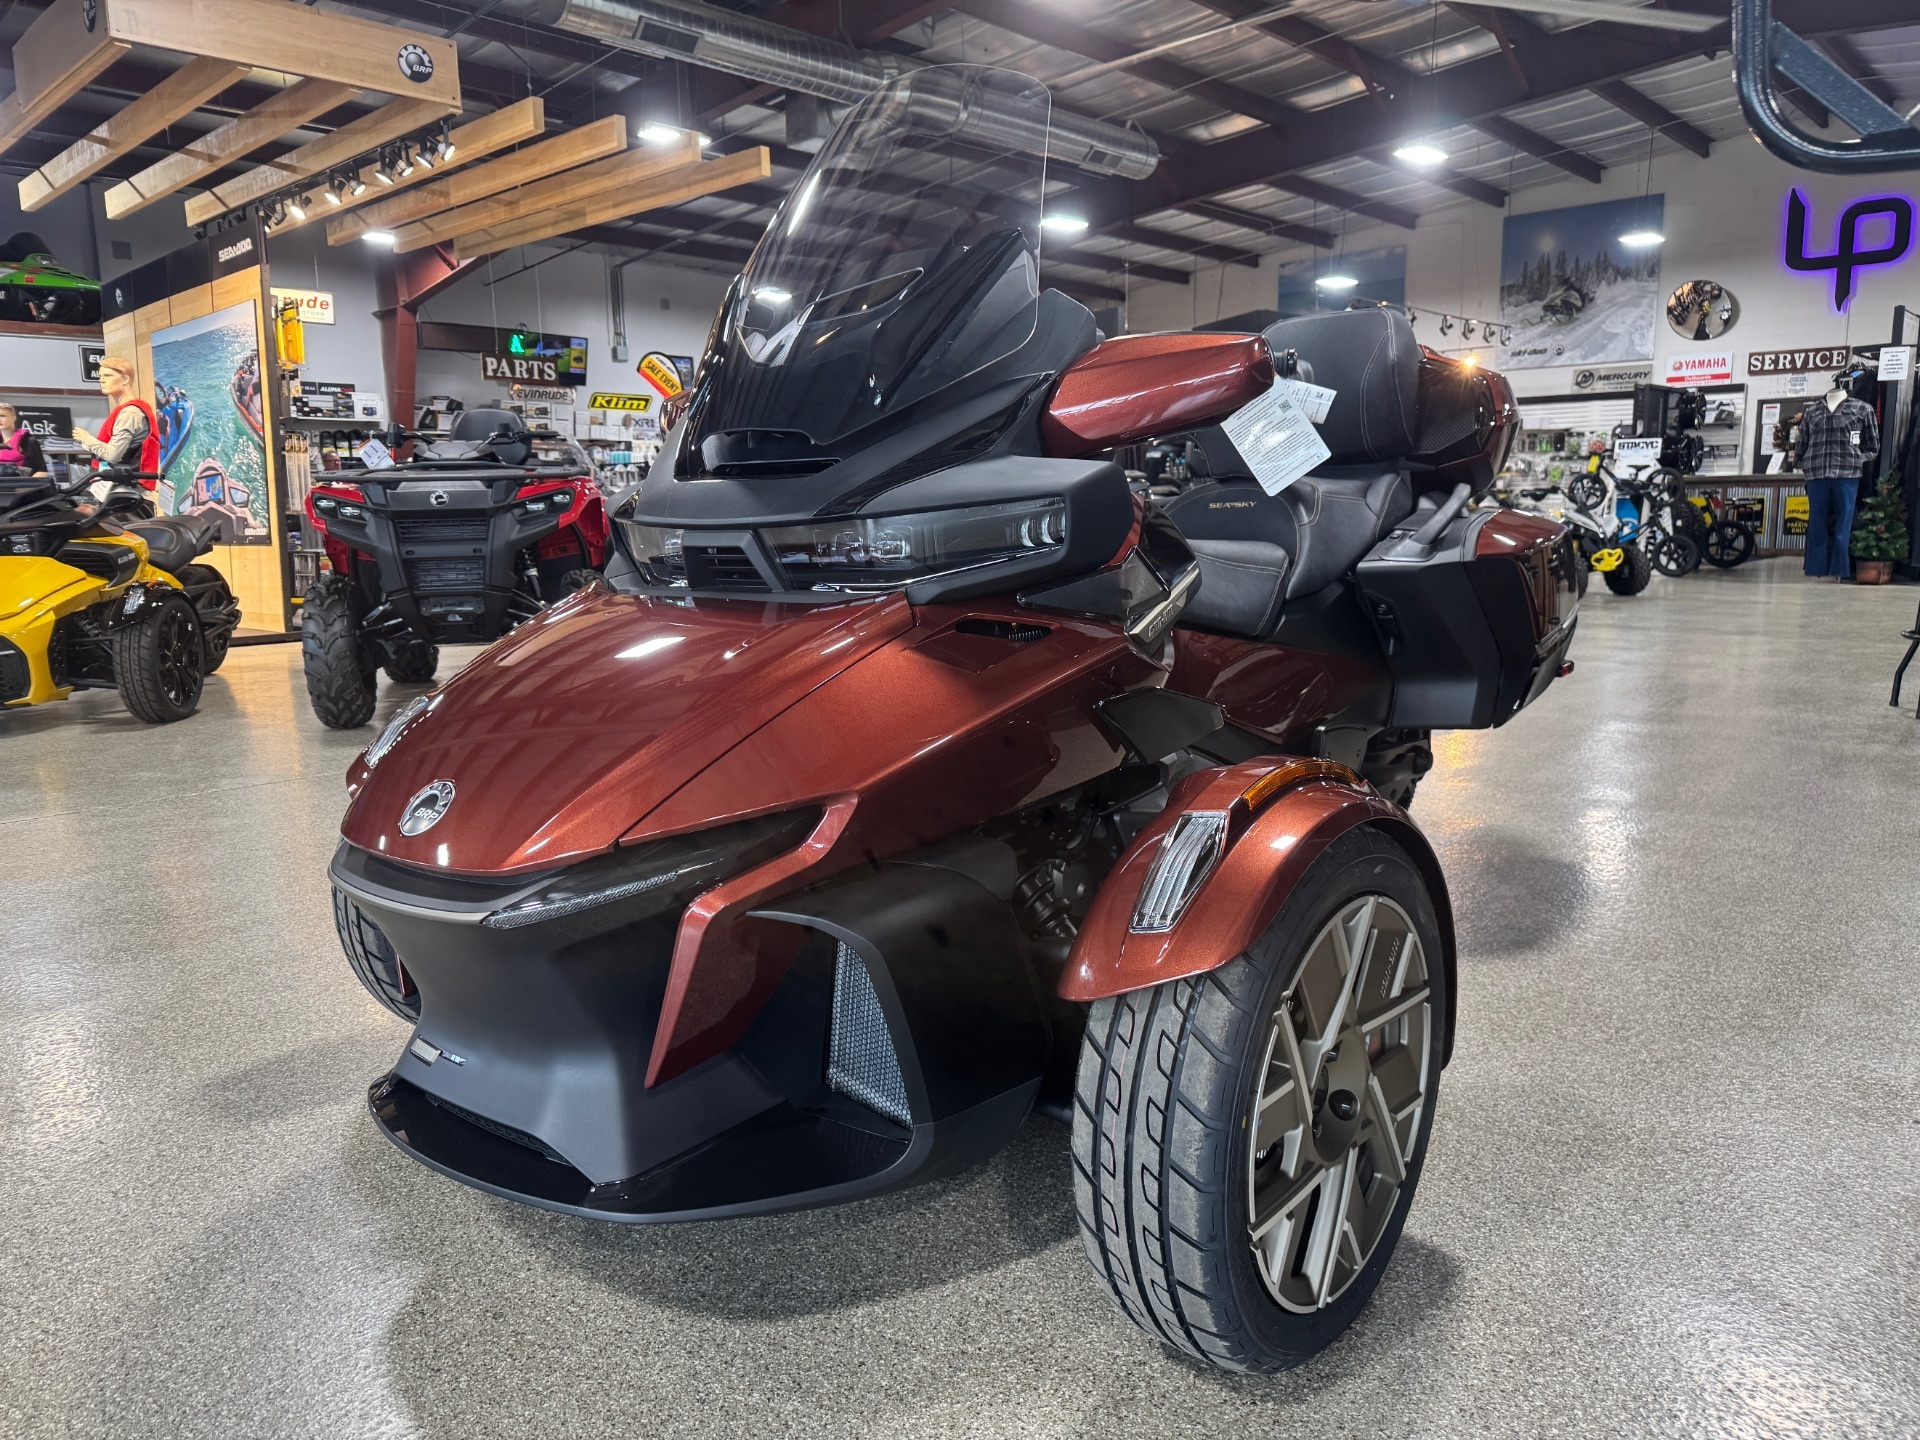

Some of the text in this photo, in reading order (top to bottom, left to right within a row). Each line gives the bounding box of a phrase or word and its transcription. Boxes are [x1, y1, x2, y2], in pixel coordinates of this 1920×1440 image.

[412, 64, 433, 74] BRP
[1685, 358, 1727, 370] YAMAHA
[1751, 350, 1846, 372] SERVICE
[485, 356, 557, 381] PARTS
[645, 360, 679, 392] SALE EVENT
[1596, 371, 1650, 382] MERCURY
[21, 420, 58, 435] Ask
[414, 807, 440, 820] BRP
